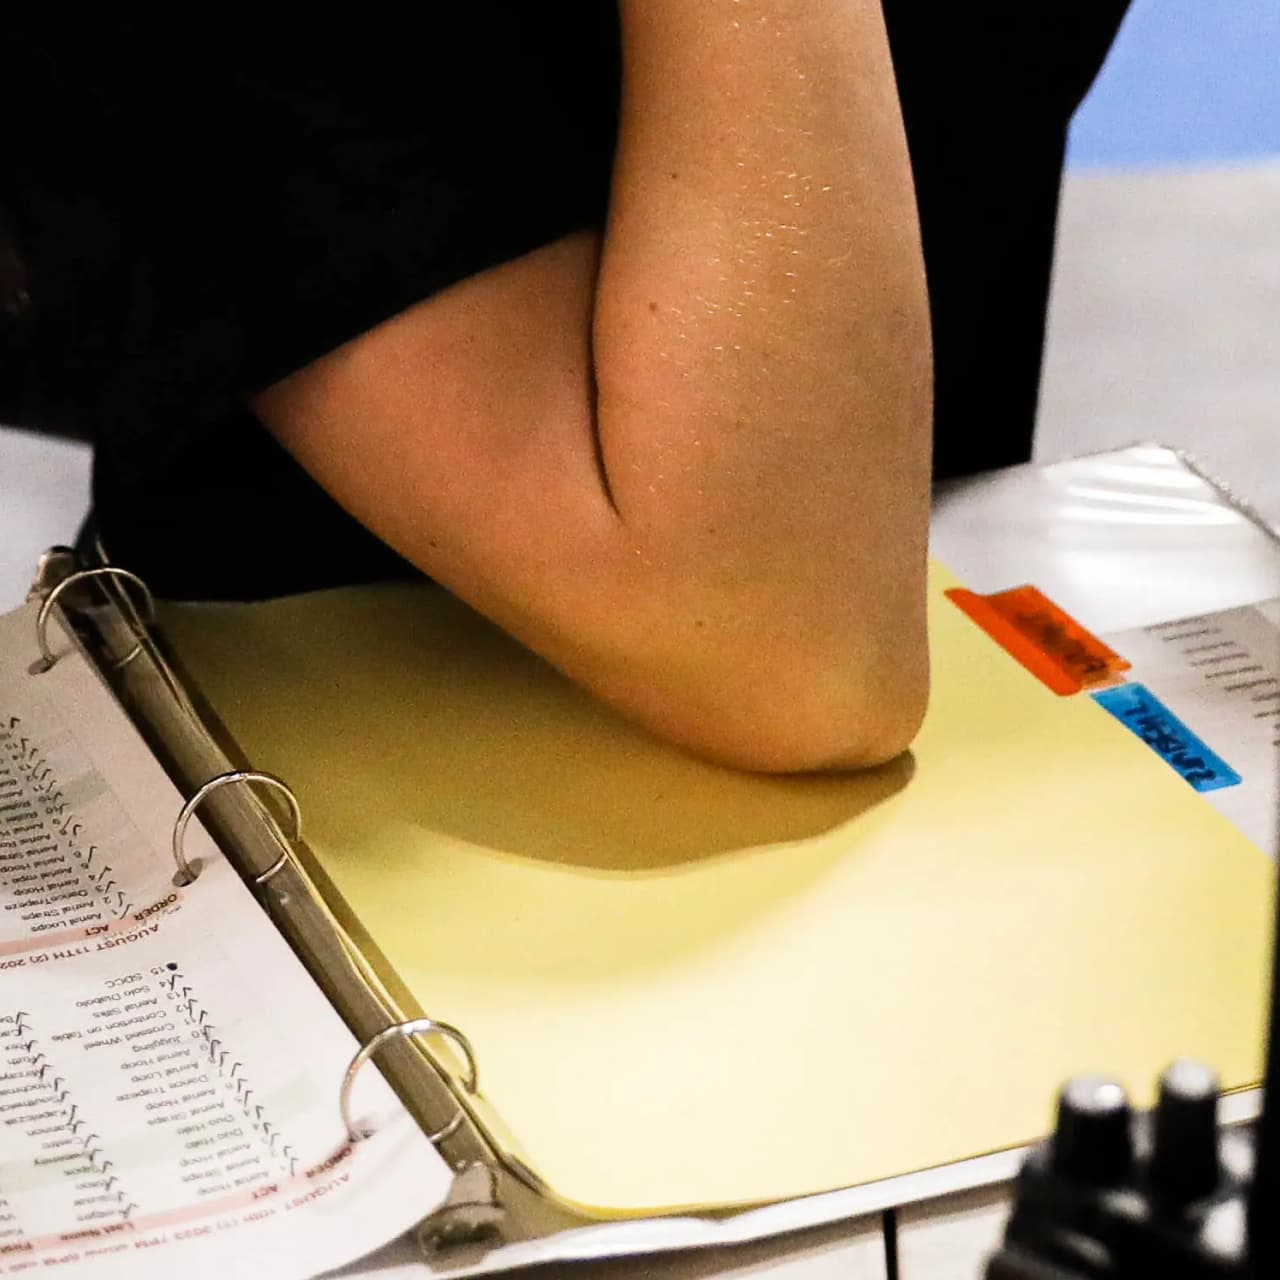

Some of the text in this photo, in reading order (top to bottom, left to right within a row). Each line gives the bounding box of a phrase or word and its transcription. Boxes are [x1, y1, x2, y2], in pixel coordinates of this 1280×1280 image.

[132, 893, 180, 923] ORDER
[84, 924, 110, 939] ACT
[96, 923, 160, 953] AUGUST
[29, 953, 50, 965] (2)
[52, 946, 92, 961] 11TH
[252, 1183, 279, 1202] ACT
